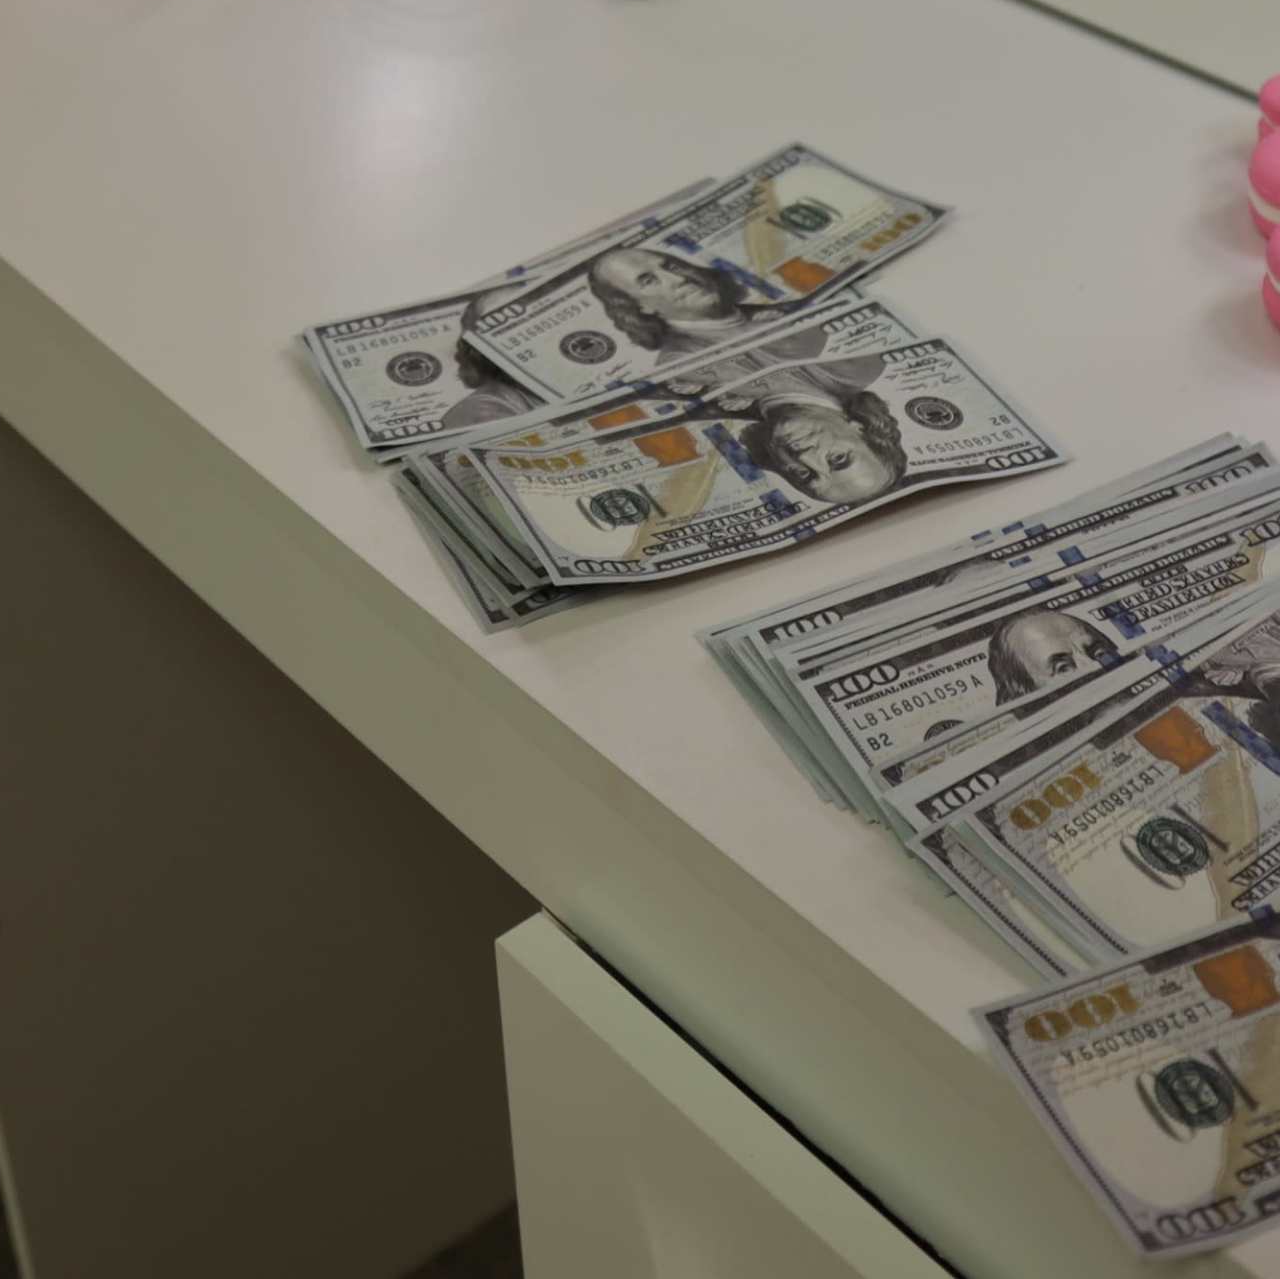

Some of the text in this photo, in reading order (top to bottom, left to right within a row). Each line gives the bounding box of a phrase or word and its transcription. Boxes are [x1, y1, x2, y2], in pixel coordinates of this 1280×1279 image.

[323, 314, 387, 339] 100
[470, 300, 529, 334] 100
[875, 341, 939, 364] 100
[382, 417, 445, 442] 100
[981, 444, 1049, 472] 100
[1167, 551, 1252, 590] STATES
[1143, 568, 1249, 616] AMERICA
[823, 661, 904, 703] 100
[897, 664, 955, 690] RESERVE
[952, 651, 988, 669] NOTE
[864, 731, 895, 751] B2
[923, 769, 1002, 818] 100
[1003, 760, 1107, 836] 100
[1016, 981, 1146, 1049] 100
[1152, 1195, 1247, 1245] 100
